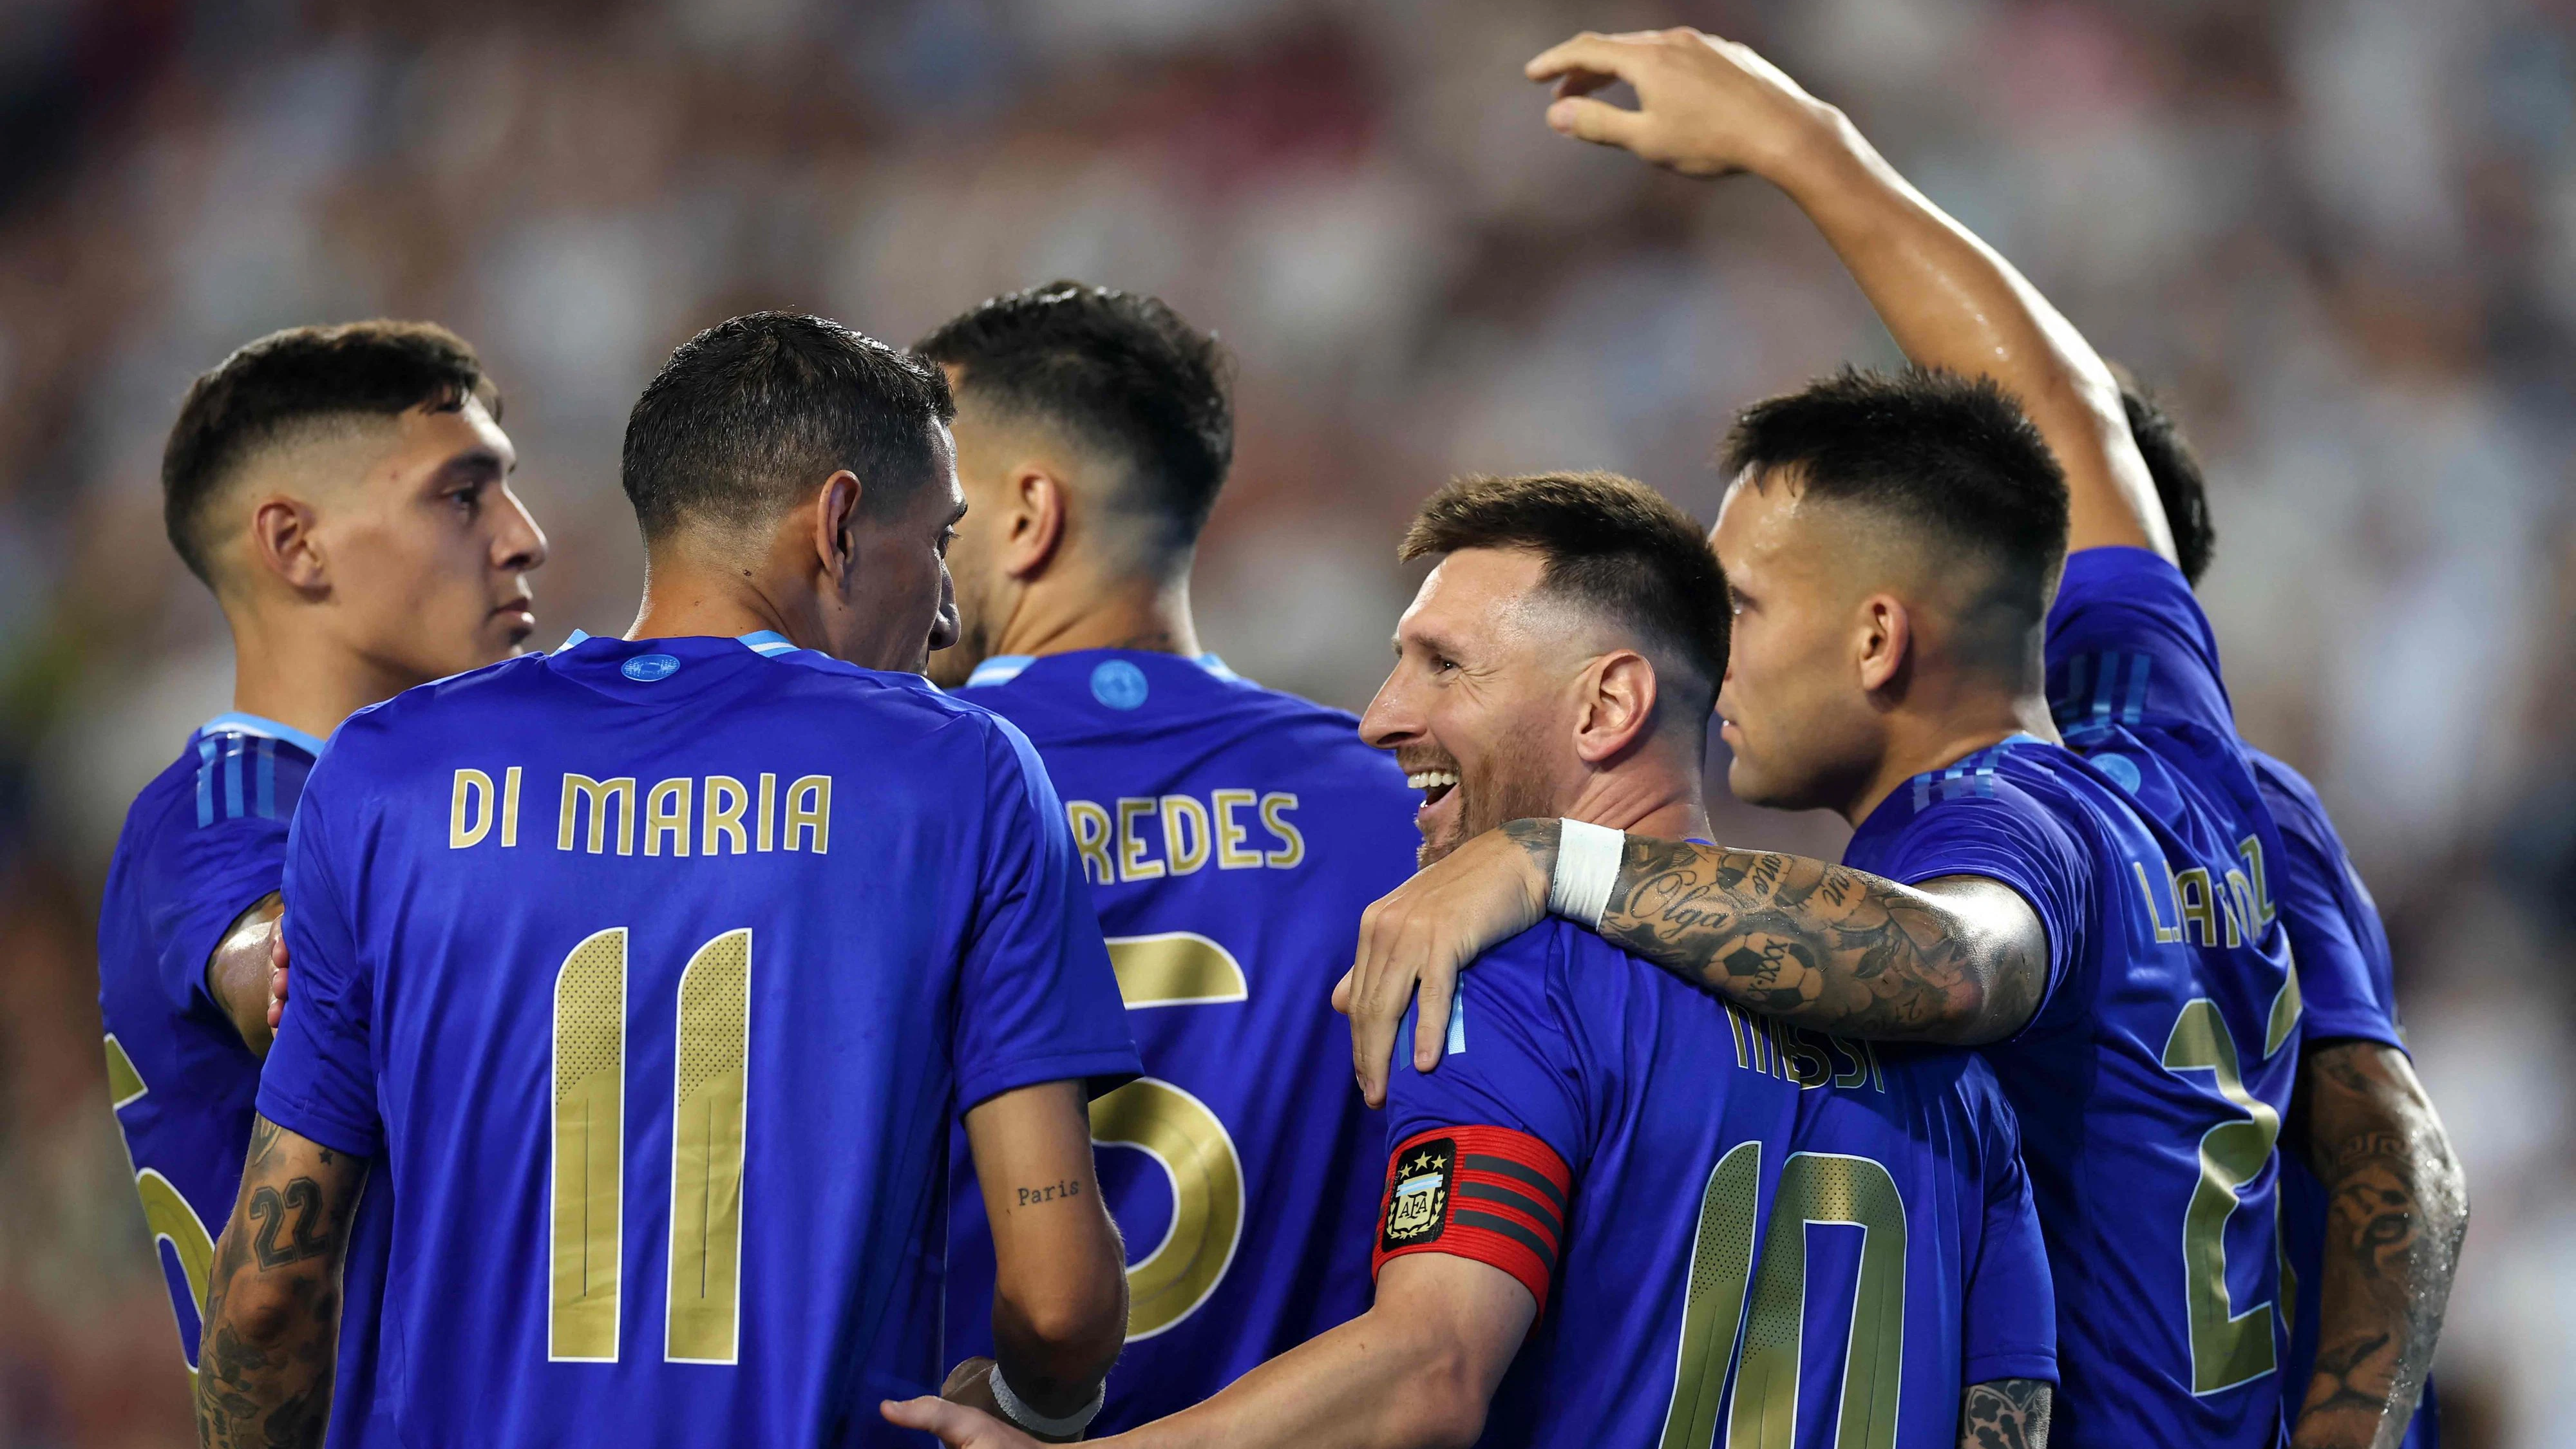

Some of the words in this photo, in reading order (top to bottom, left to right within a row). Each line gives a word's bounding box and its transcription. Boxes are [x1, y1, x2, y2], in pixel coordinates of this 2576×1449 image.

[450, 766, 522, 849] DI
[556, 772, 832, 857] MARIA
[1066, 788, 1305, 886] REDES
[1630, 870, 1731, 940] Olga
[548, 926, 752, 1366] 11
[1018, 1180, 1079, 1206] Paris
[250, 1176, 331, 1273] 22
[1397, 1191, 1428, 1220] AFA
[1658, 1140, 1908, 1449] 10
